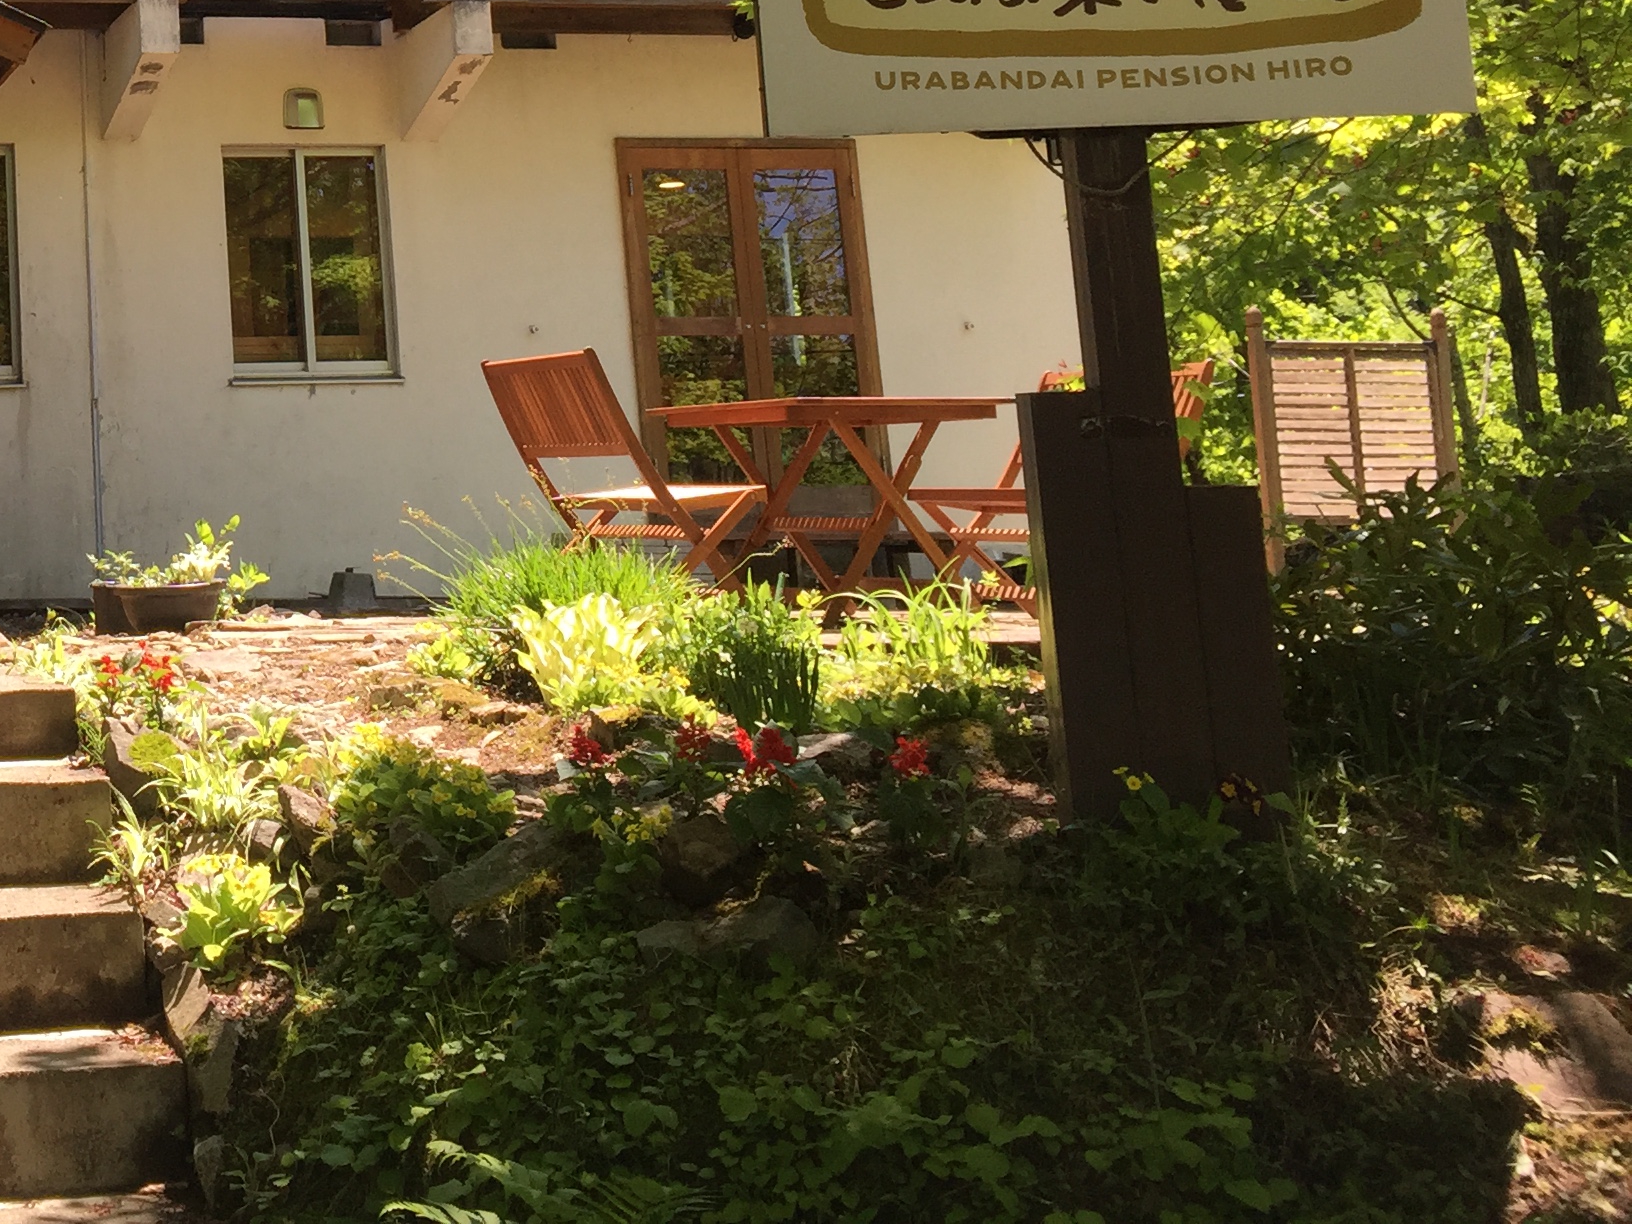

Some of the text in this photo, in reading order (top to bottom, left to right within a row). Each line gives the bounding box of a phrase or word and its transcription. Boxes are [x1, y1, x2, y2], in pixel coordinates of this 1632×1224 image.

[873, 55, 1353, 91] URABANDAI PENSION HIRO
